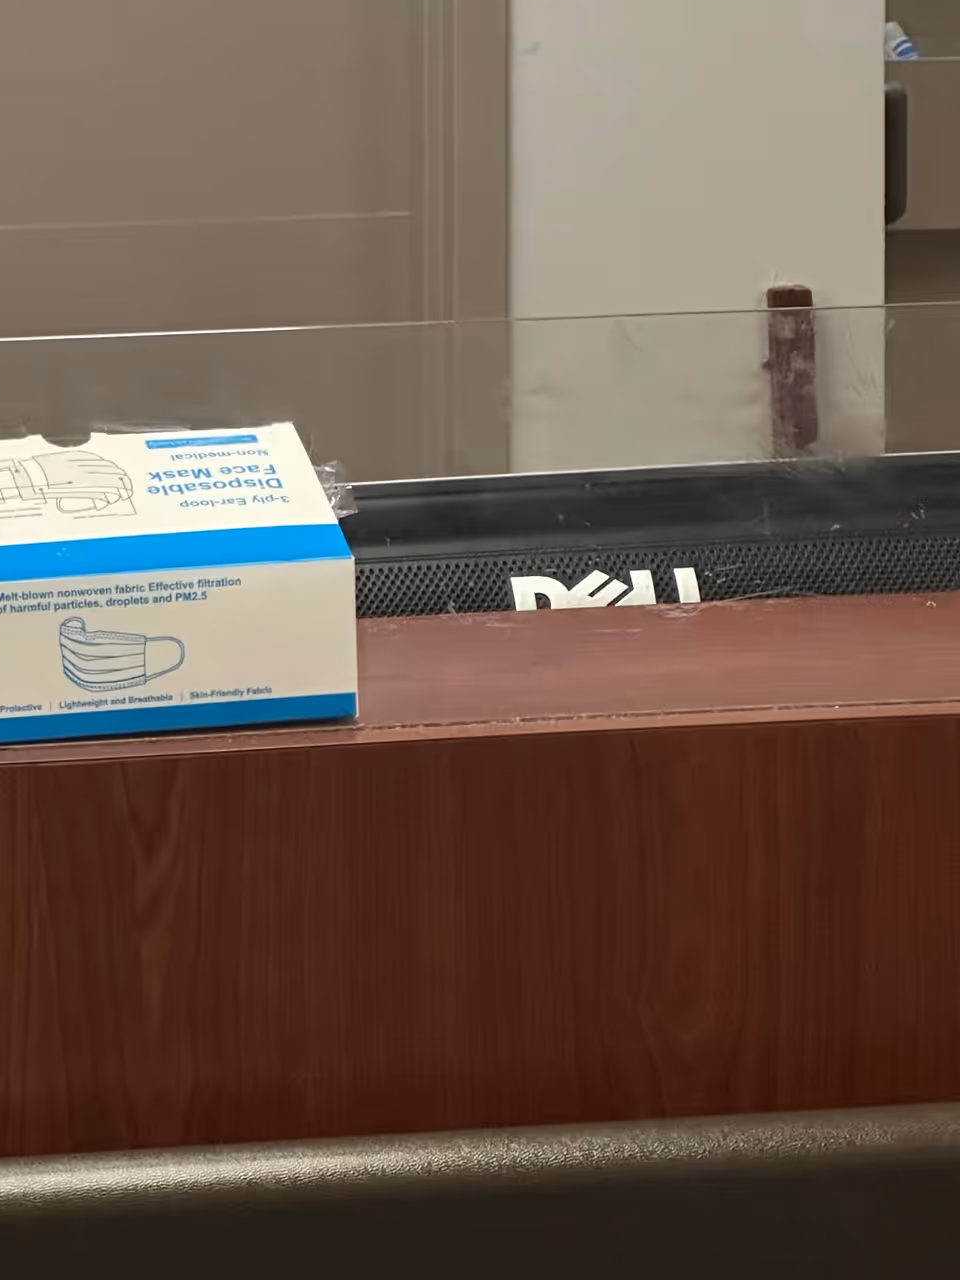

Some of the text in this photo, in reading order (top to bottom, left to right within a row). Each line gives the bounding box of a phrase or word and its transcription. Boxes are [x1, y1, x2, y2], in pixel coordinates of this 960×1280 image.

[171, 449, 269, 461] Non-medical
[148, 464, 276, 482] Face Mask
[147, 477, 283, 496] Disposable
[180, 495, 289, 507] 3-ply Ear-loop
[57, 586, 112, 598] nonwoven
[115, 583, 145, 595] fabric
[148, 580, 194, 592] Effective
[197, 577, 241, 589] filtration
[10, 601, 50, 613] harmful
[54, 598, 102, 612] particles,
[106, 595, 149, 607] droplets
[152, 594, 172, 604] and
[175, 591, 207, 602] PM2.5
